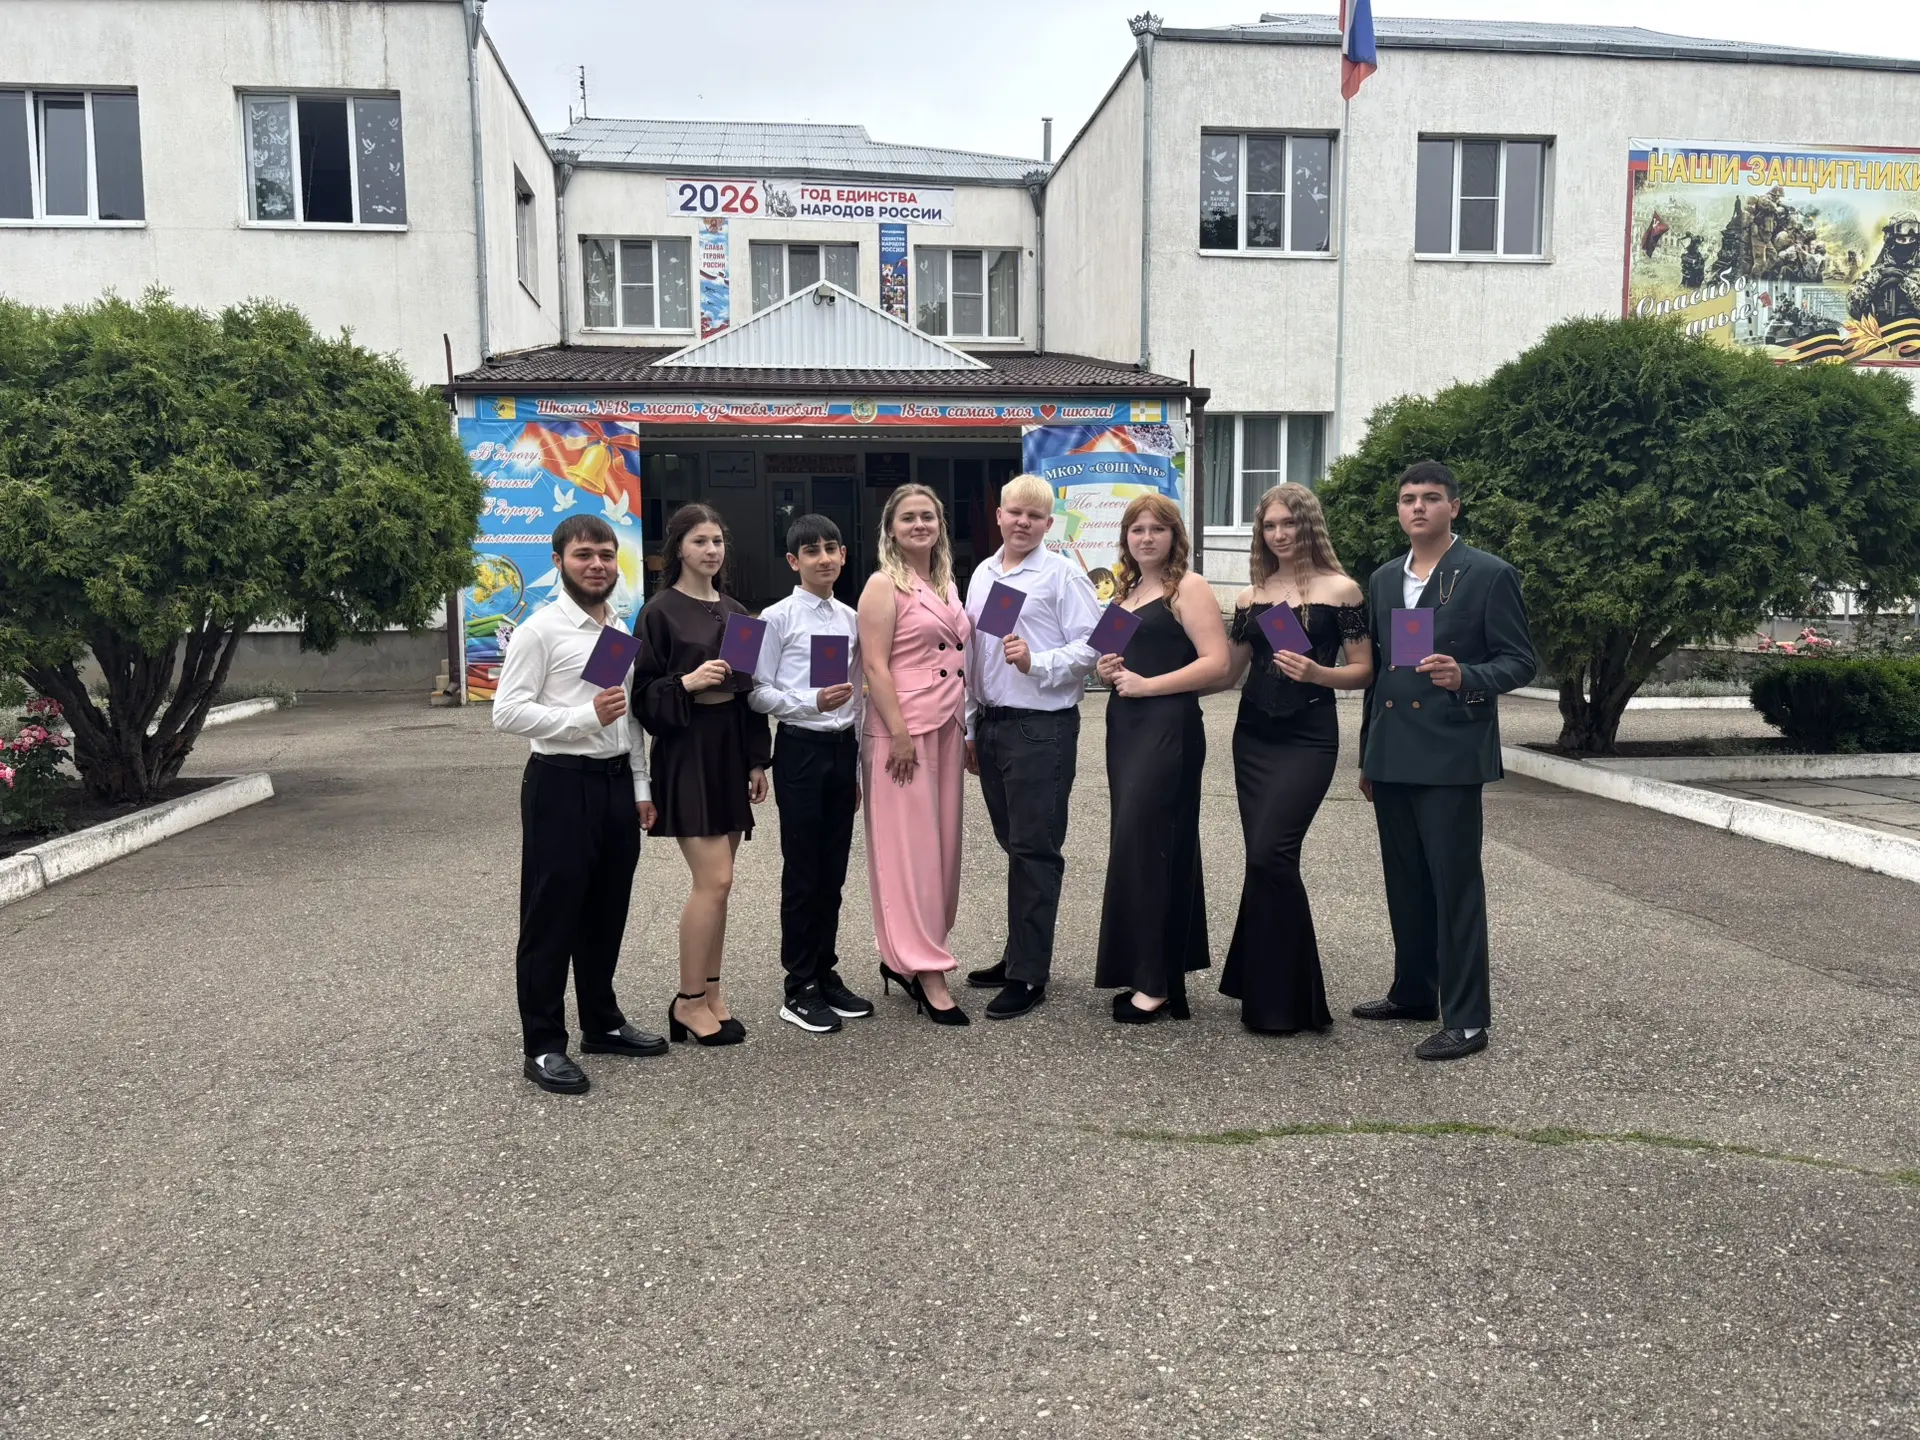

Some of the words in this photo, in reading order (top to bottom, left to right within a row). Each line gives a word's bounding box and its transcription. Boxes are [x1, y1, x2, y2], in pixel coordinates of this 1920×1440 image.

[1648, 152, 1740, 185] НАШИ
[678, 183, 759, 214] 2026
[801, 188, 831, 203] ГОД
[837, 189, 918, 204] ЕДИНСТВА
[801, 204, 875, 218] НАРОДОВ
[879, 206, 942, 220] РОССИИ
[704, 243, 724, 251] СЛАВА
[703, 252, 725, 260] ГЕРОЯМ
[702, 261, 726, 269] РОССИИ
[537, 399, 589, 415] Школа
[592, 399, 630, 415] №18
[643, 402, 699, 417] место,
[702, 403, 727, 421] где
[729, 402, 768, 416] тебя
[769, 400, 830, 416] любят!
[900, 402, 941, 418] 18-ая
[945, 405, 995, 418] самая
[1002, 406, 1034, 418] моя
[1061, 403, 1115, 419] школа!
[1044, 463, 1085, 481] МКОУ
[1088, 462, 1129, 473] «СОШ
[1132, 463, 1166, 478] №18»
[1066, 492, 1100, 510] По
[1096, 500, 1128, 509] лесен
[1079, 520, 1121, 529] знани
